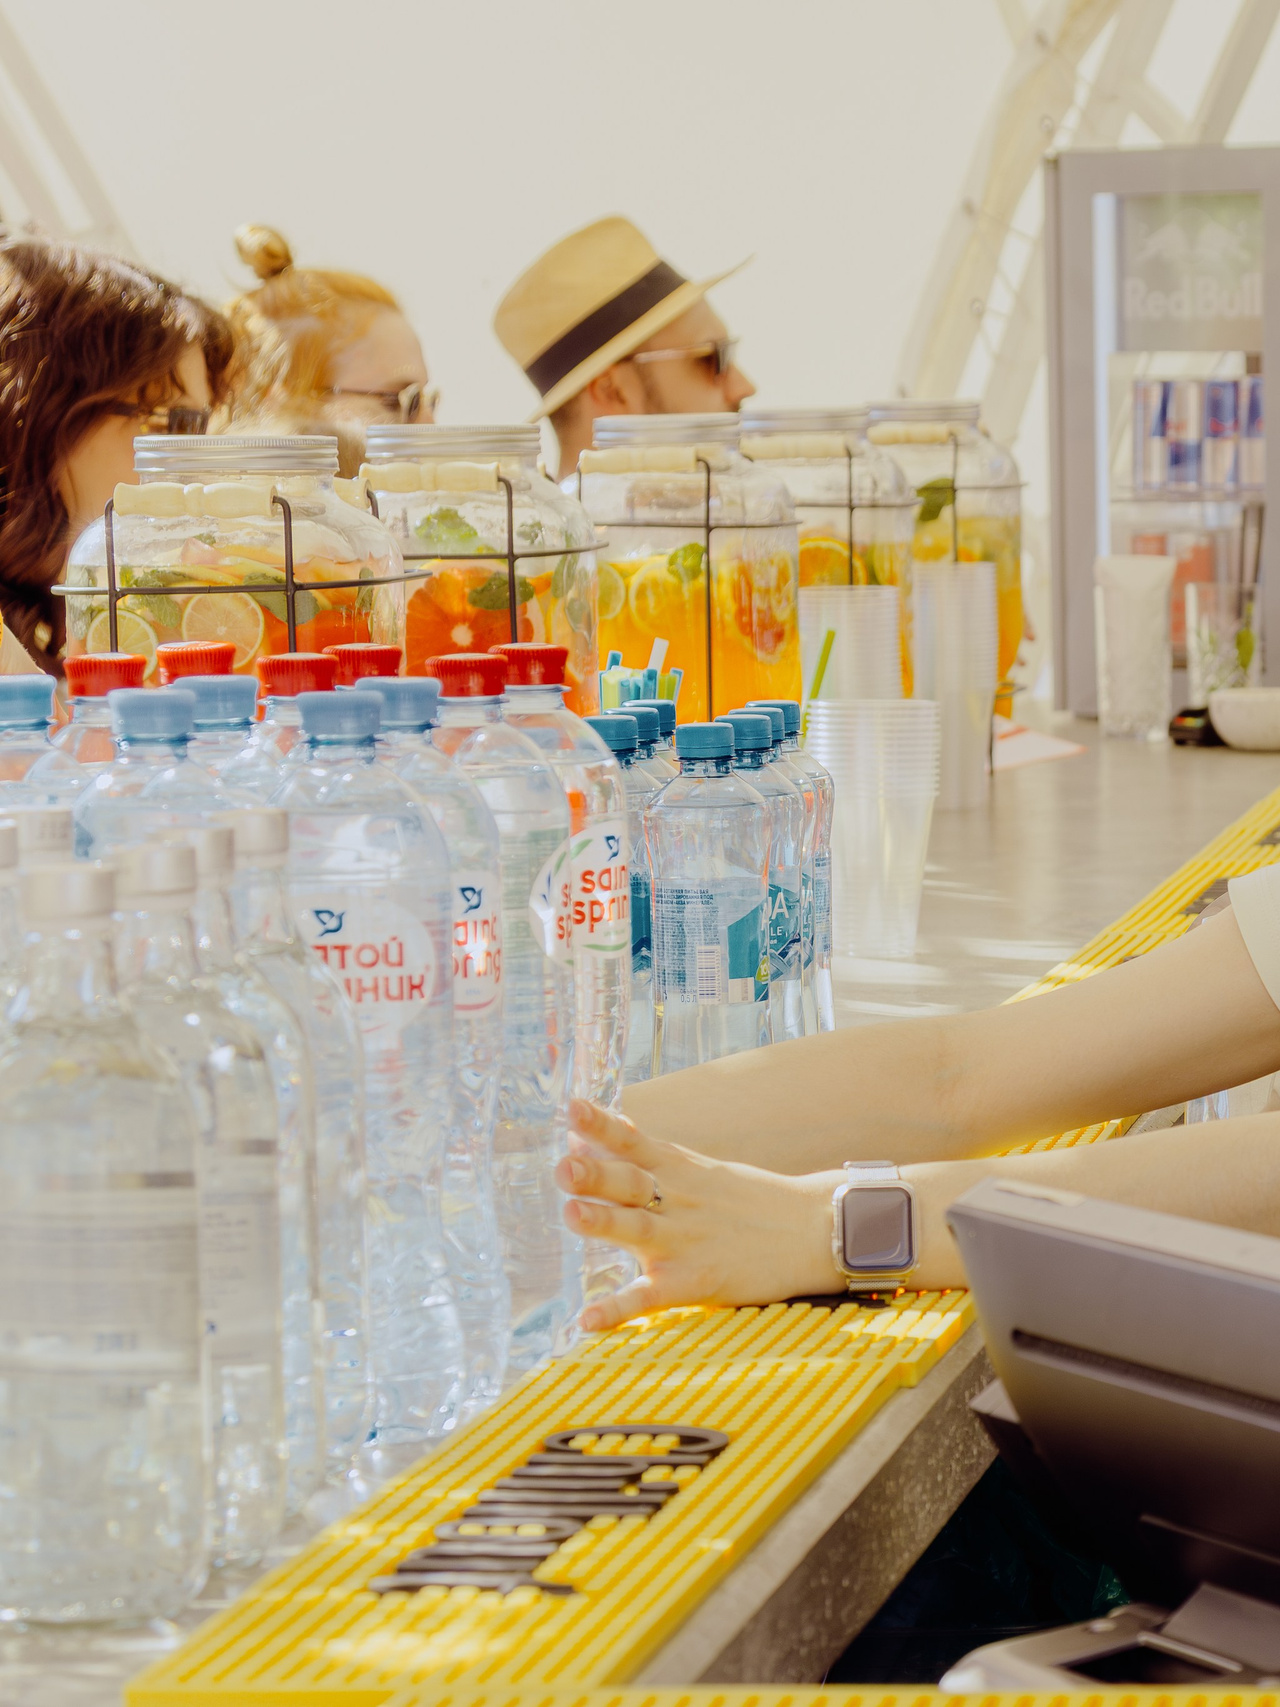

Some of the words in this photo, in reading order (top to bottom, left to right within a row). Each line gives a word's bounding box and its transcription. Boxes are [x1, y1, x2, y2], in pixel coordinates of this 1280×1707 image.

[580, 865, 629, 894] sain
[453, 912, 497, 946] aint
[572, 894, 629, 933] sprin
